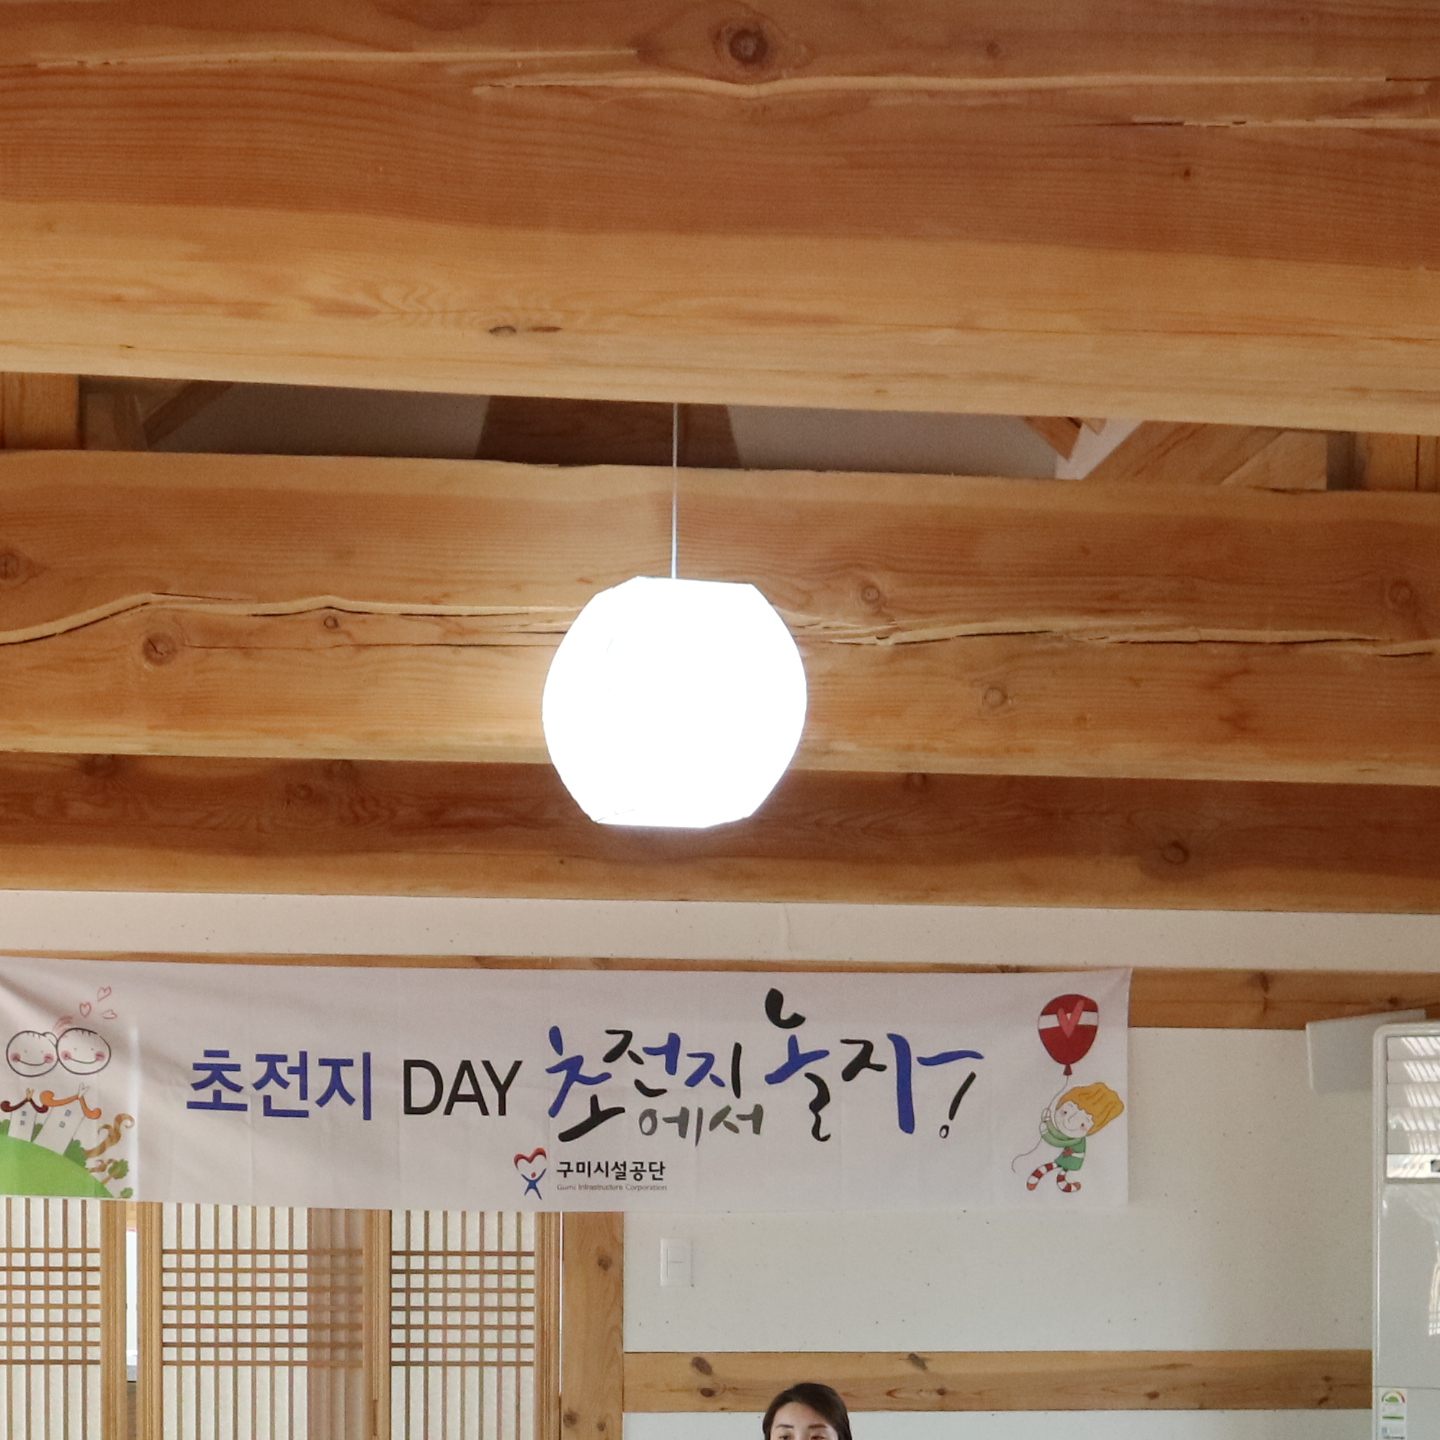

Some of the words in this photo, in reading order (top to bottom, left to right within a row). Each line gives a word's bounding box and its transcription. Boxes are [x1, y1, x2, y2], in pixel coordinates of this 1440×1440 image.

[186, 1049, 372, 1121] 초전지
[403, 1059, 523, 1117] DAY
[556, 1161, 666, 1181] 구미시설공단
[556, 1183, 576, 1191] Gumi
[578, 1183, 623, 1191] Infrastructure
[625, 1183, 667, 1192] Corporation
